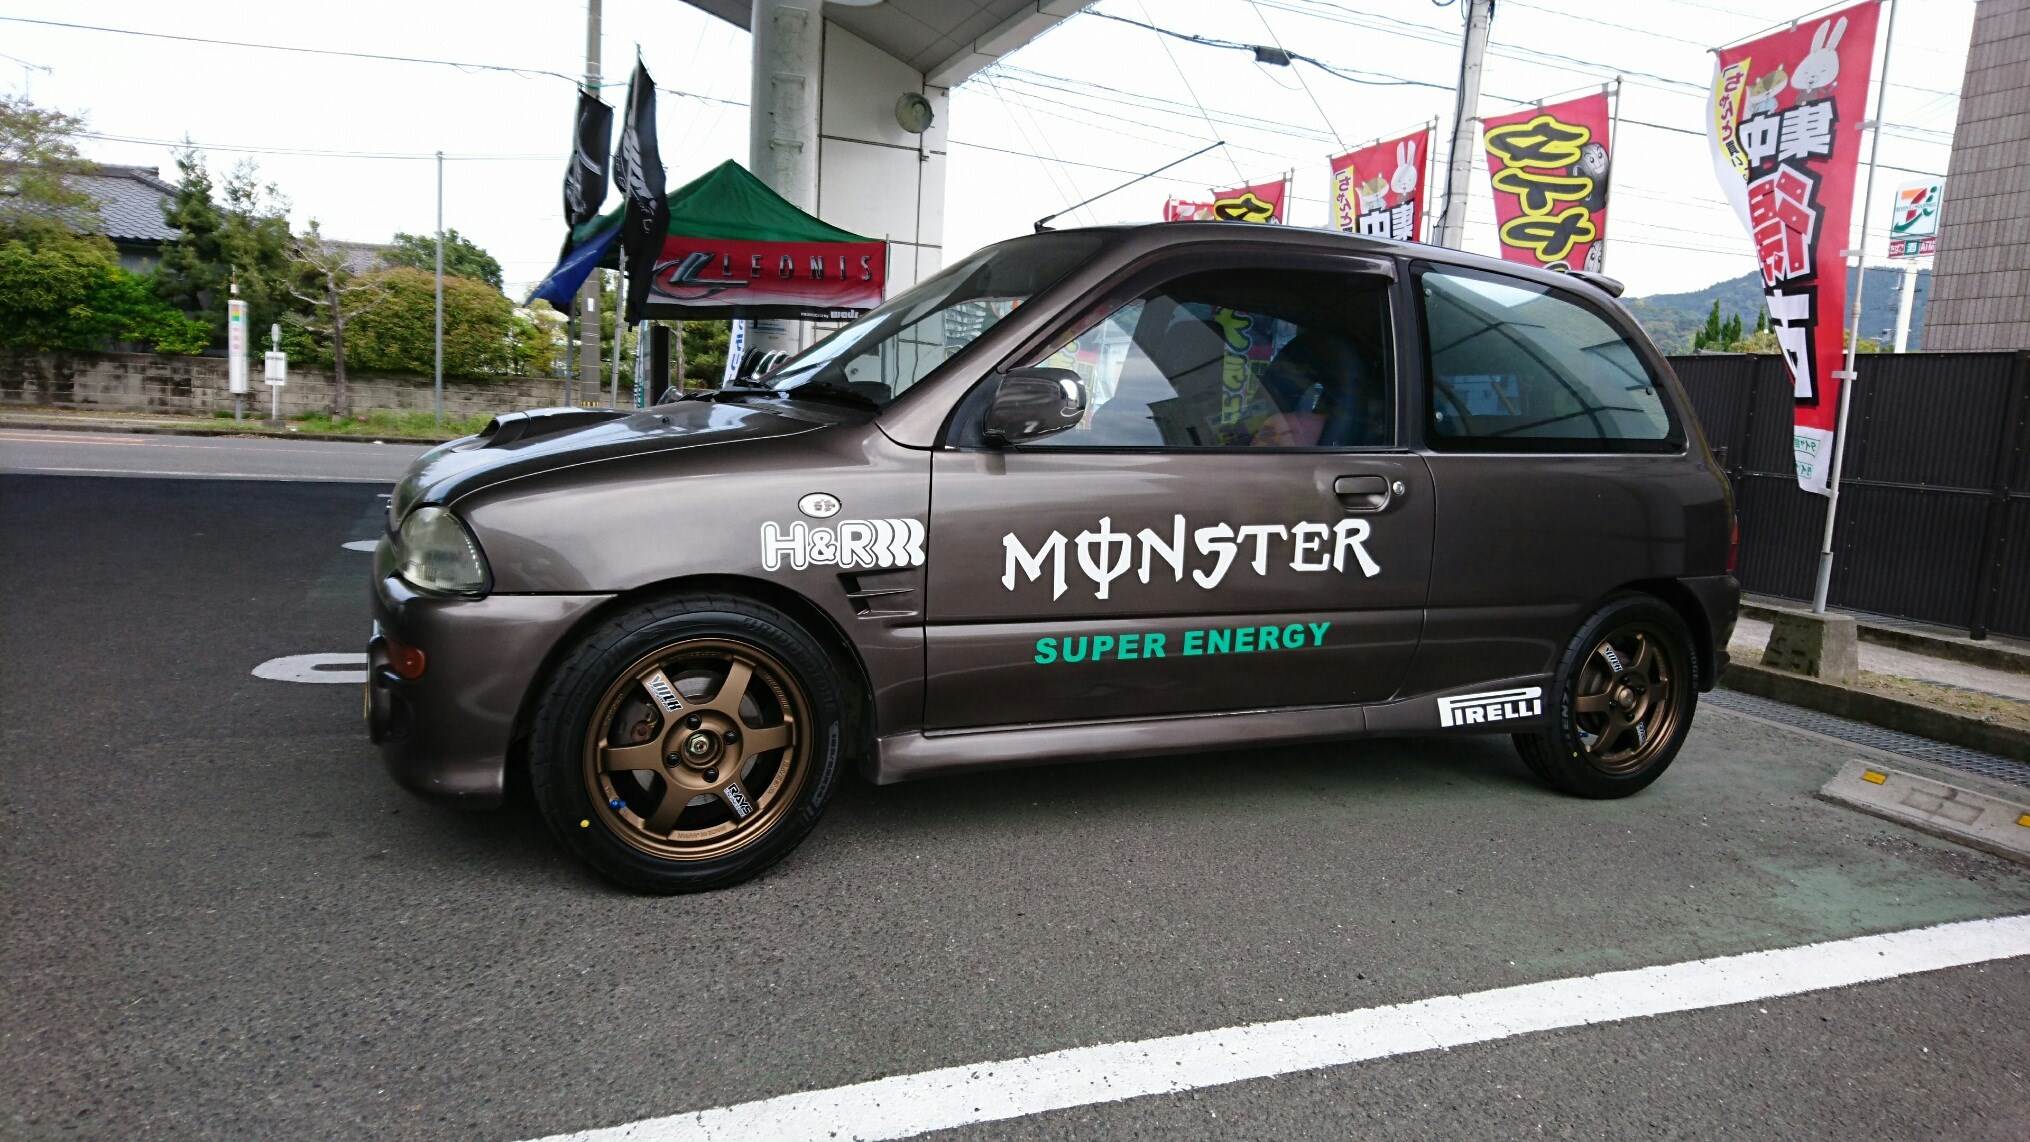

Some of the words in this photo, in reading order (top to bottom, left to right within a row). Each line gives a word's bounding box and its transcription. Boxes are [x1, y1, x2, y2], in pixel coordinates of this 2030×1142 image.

[723, 253, 873, 282] LEONIS
[1001, 514, 1381, 601] MONSTER
[1034, 632, 1166, 664] SUPER
[1183, 621, 1331, 656] ENERGY
[1437, 686, 1542, 728] PIRELLI
[728, 783, 754, 816] RAYS
